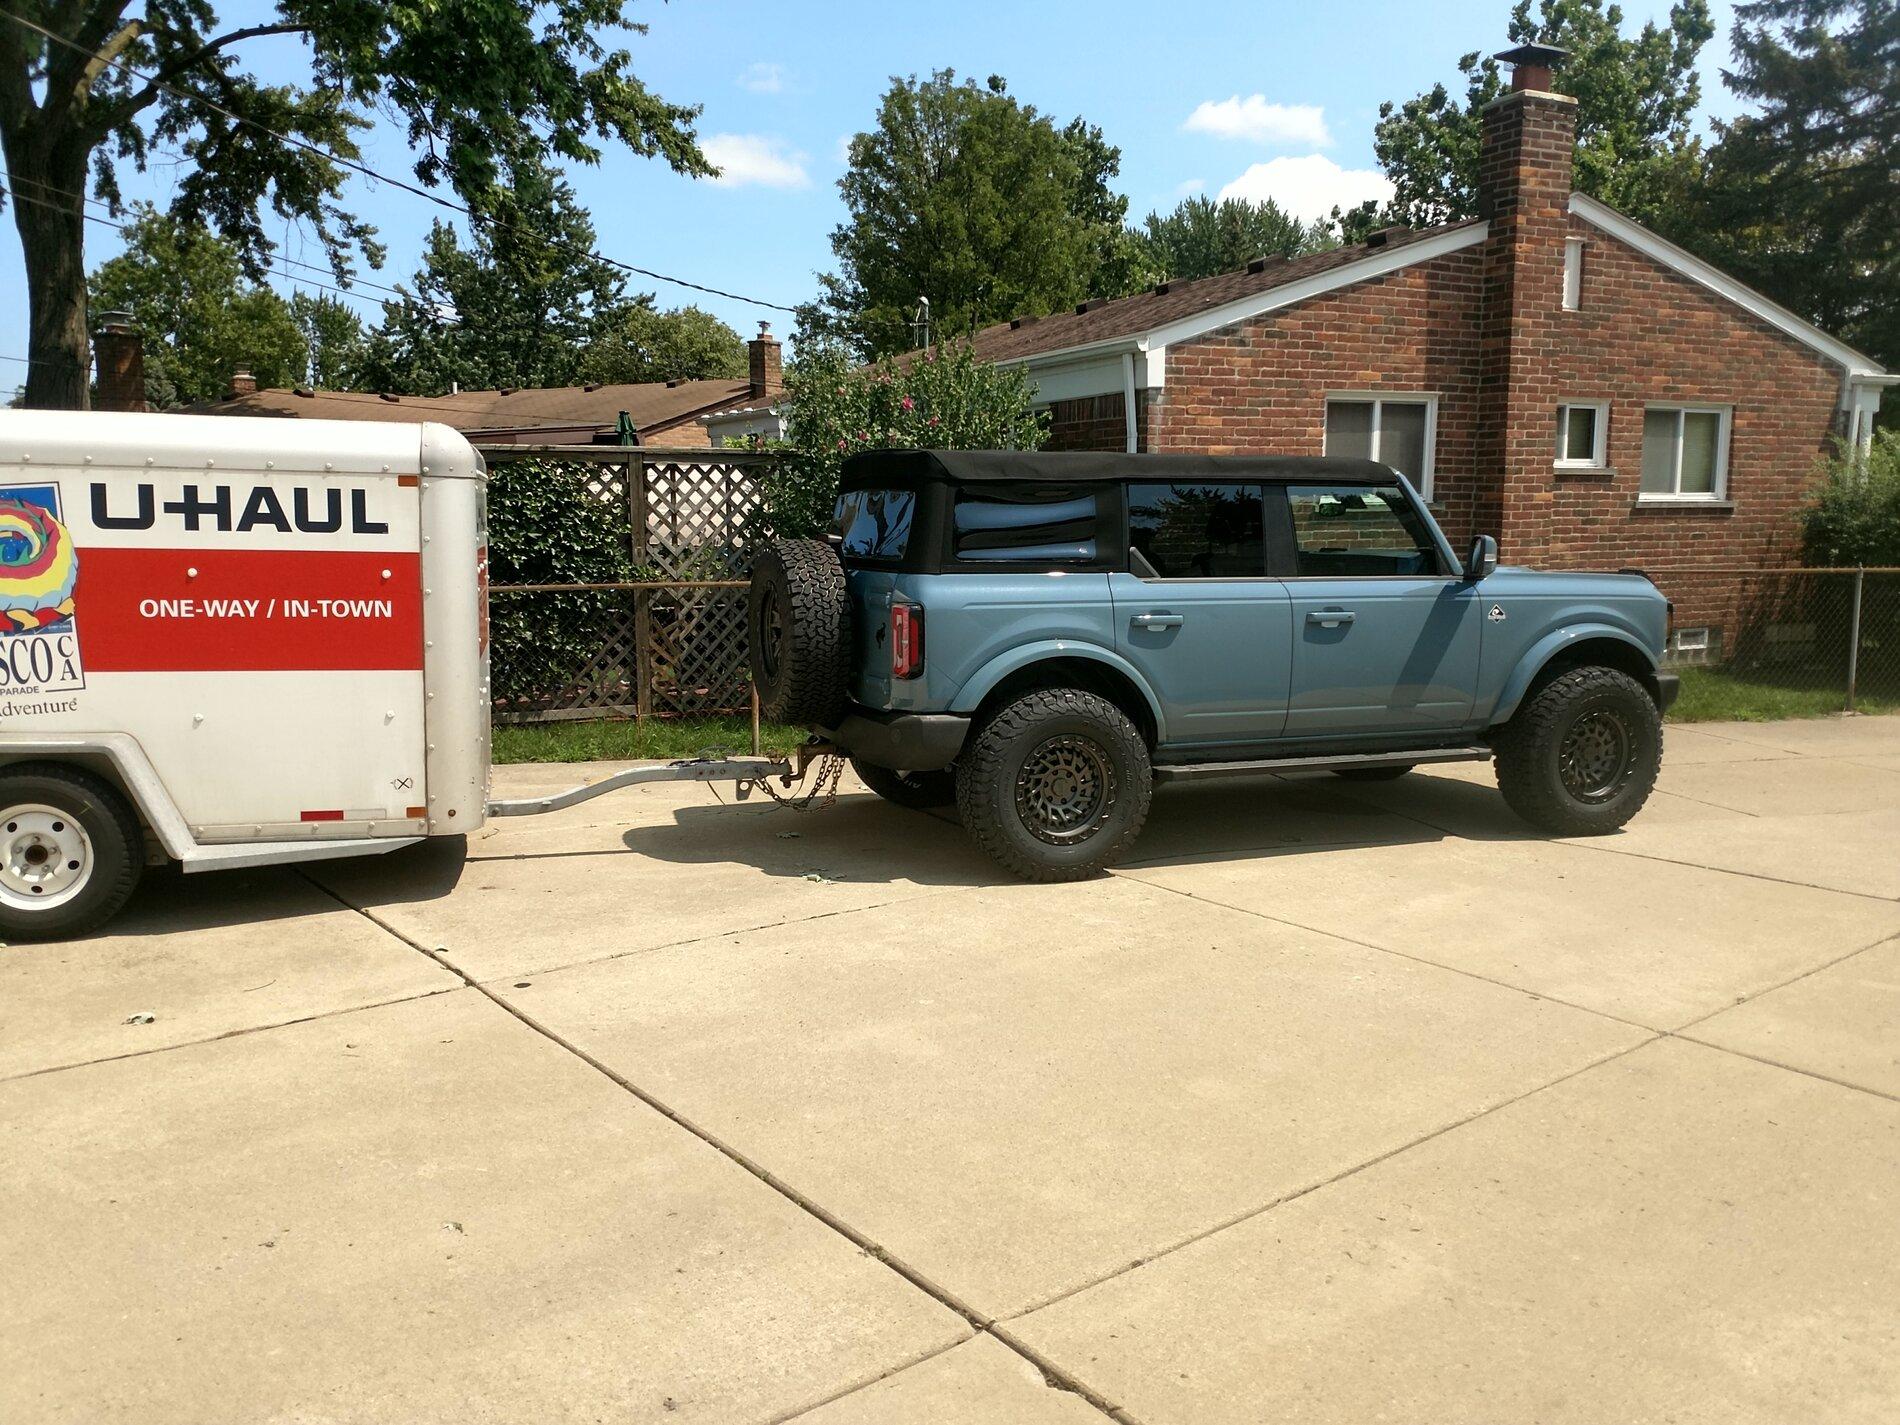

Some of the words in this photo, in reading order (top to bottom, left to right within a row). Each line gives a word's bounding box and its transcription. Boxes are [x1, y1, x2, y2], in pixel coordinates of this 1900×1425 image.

[139, 599, 259, 618] ONE-WAY
[283, 600, 393, 619] IN-TOWN
[0, 685, 40, 696] PARADE
[0, 701, 78, 717] dventure
